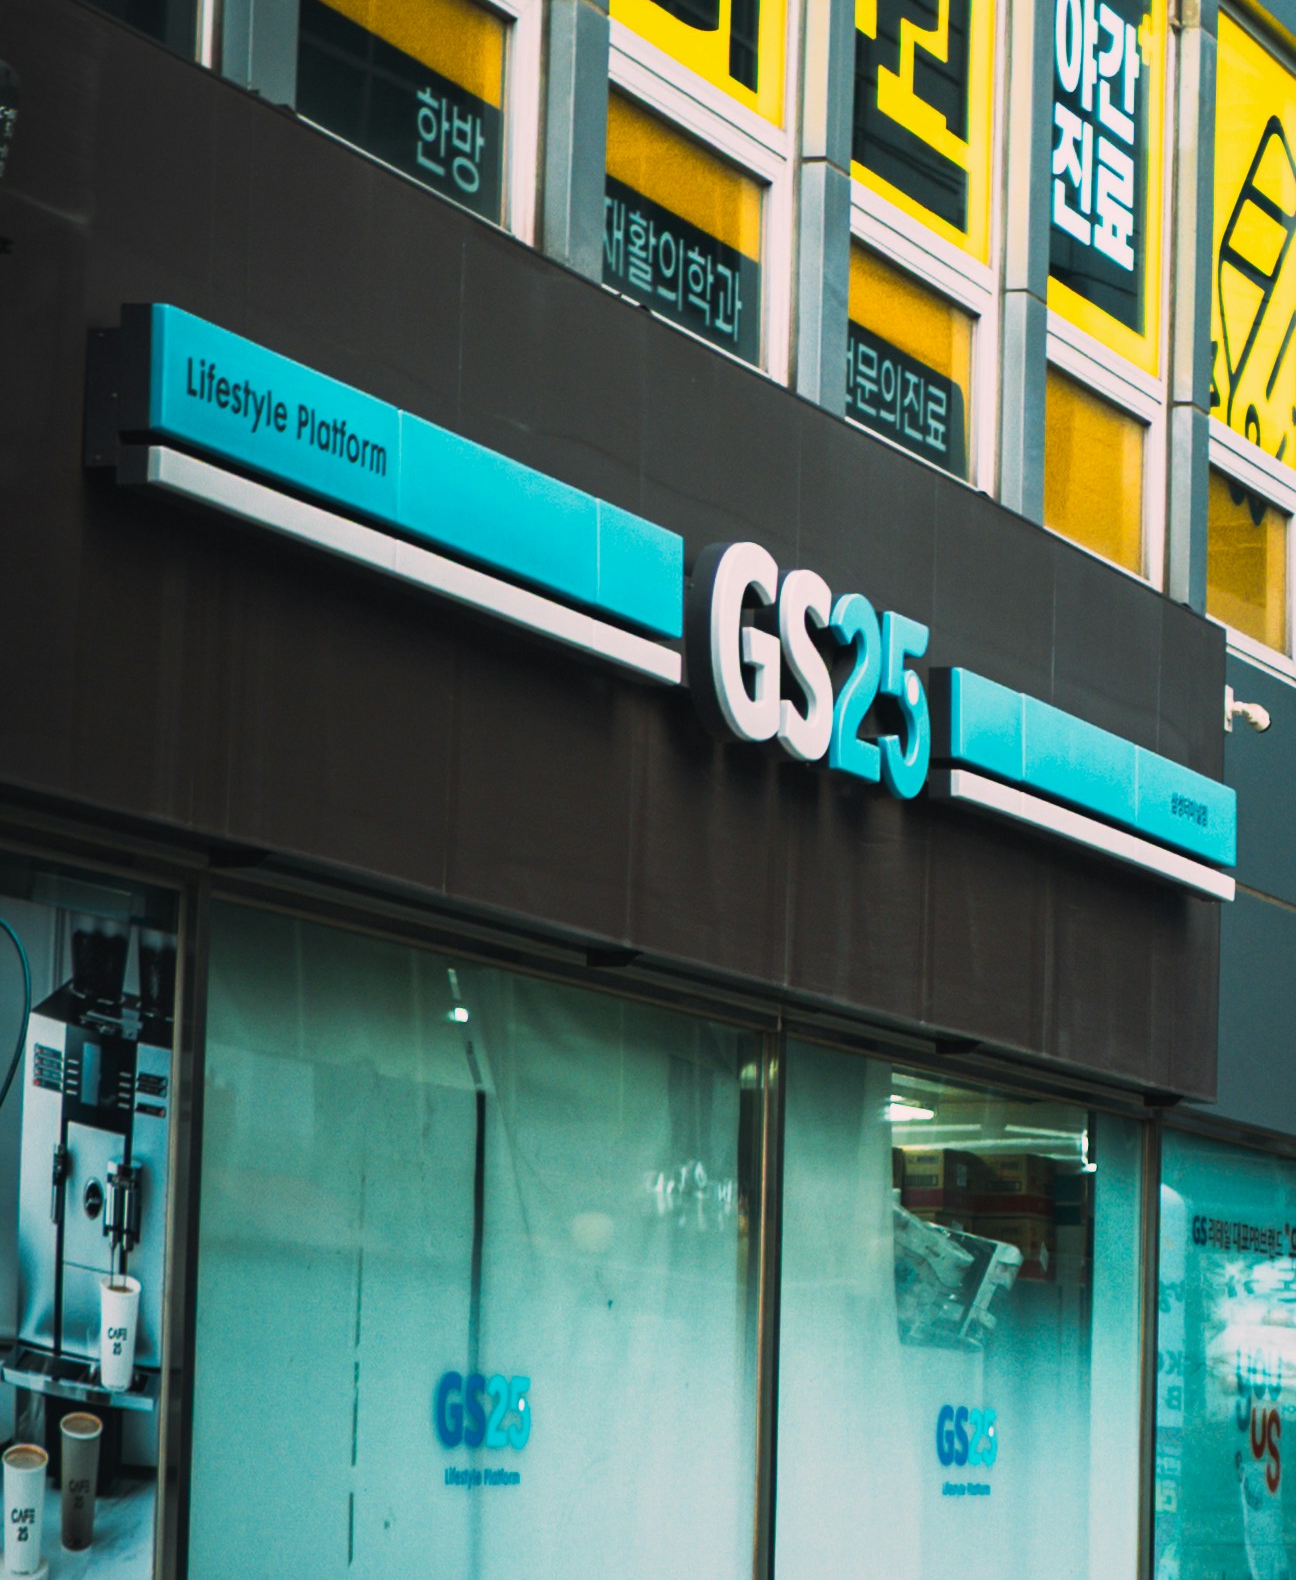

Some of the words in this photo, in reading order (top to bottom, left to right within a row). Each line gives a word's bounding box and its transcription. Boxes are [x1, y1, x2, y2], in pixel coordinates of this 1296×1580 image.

[416, 86, 485, 194] 한방
[1050, 119, 1136, 274] 진료
[186, 355, 288, 434] Lifestyle
[297, 403, 389, 478] Platform
[709, 540, 931, 800] GS25
[436, 1370, 532, 1452] GS25
[936, 1404, 999, 1469] GS25
